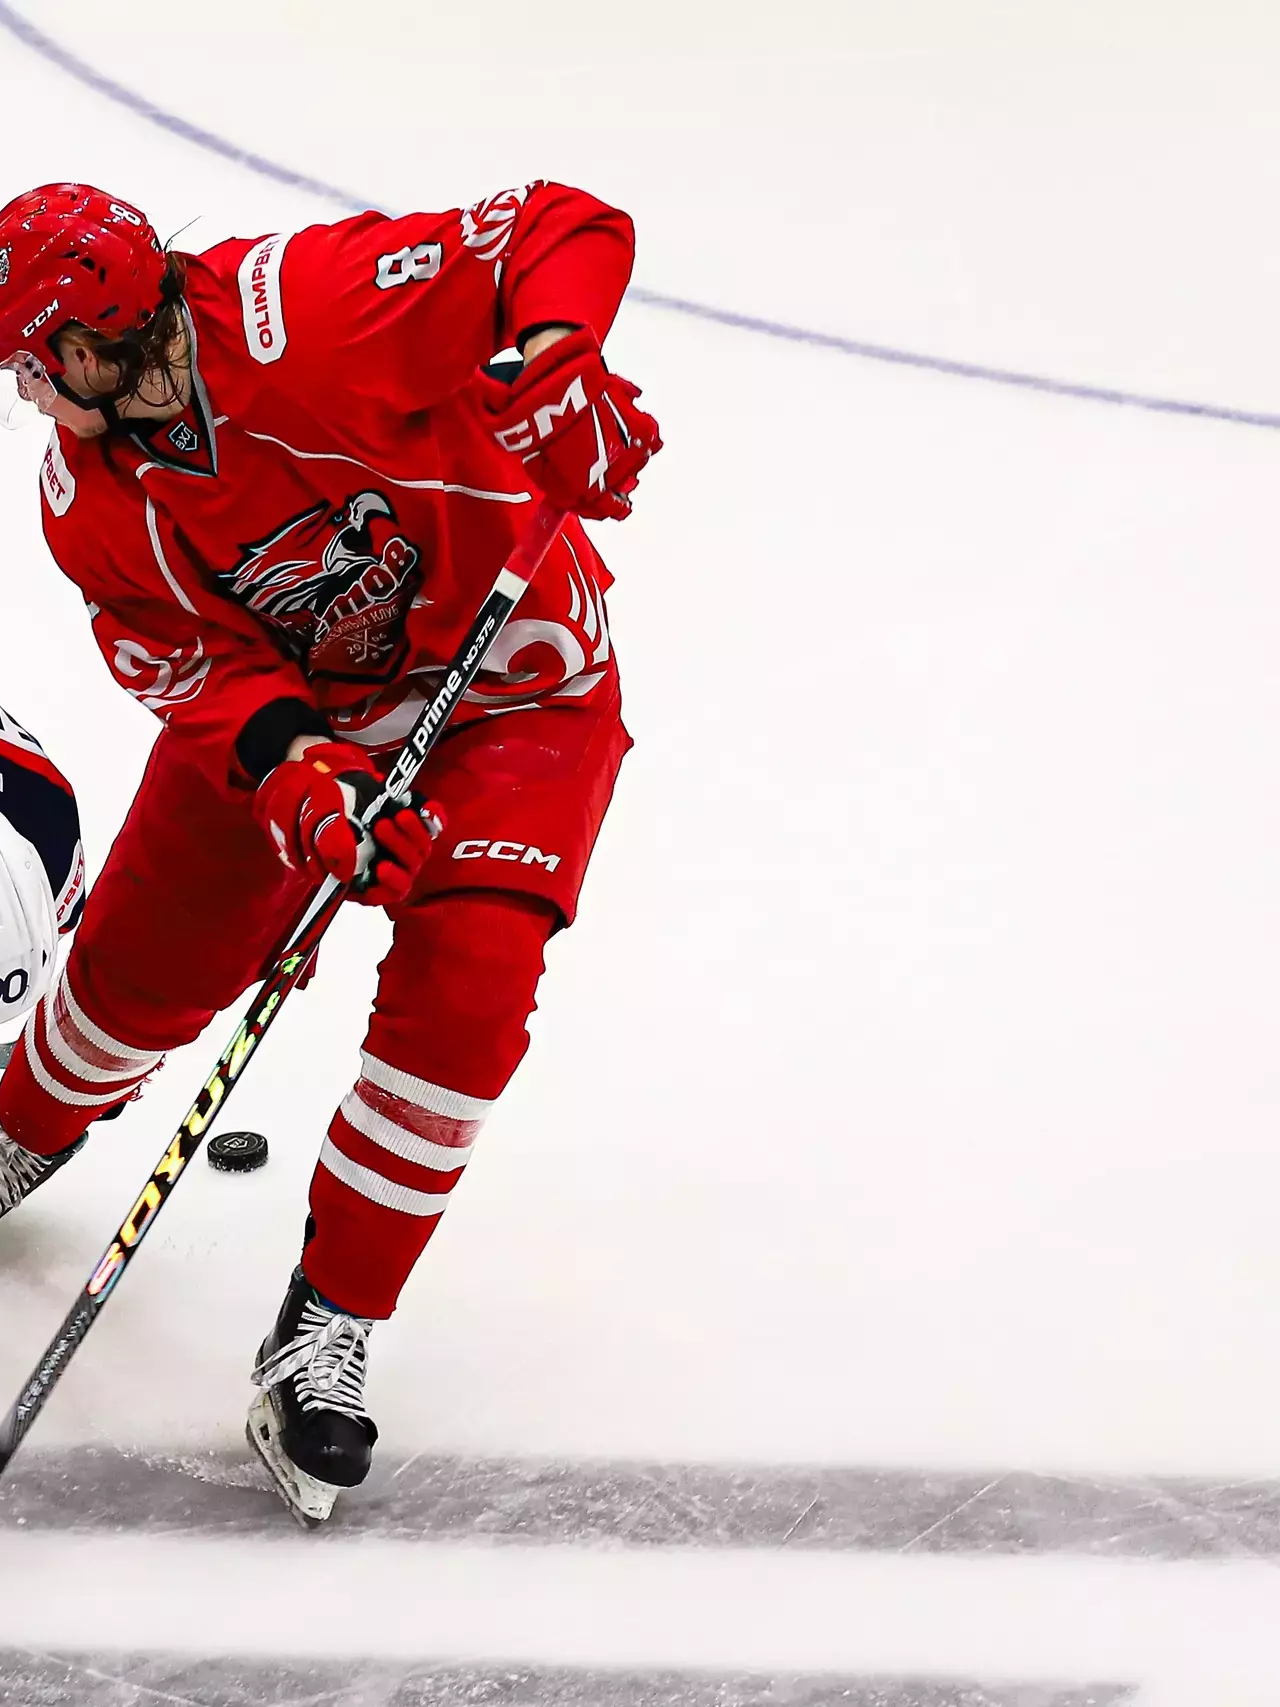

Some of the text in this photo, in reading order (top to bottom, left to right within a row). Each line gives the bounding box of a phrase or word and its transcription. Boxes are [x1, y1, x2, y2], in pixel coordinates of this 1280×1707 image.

[110, 202, 141, 226] 8
[375, 241, 442, 290] 8
[22, 299, 59, 338] CCM
[494, 375, 588, 452] CM
[44, 448, 66, 500] PBET
[386, 747, 417, 799] CE
[412, 670, 462, 755] prime
[452, 840, 561, 872] CCM
[57, 853, 84, 922] PBET
[86, 1017, 256, 1305] SOYUZ
